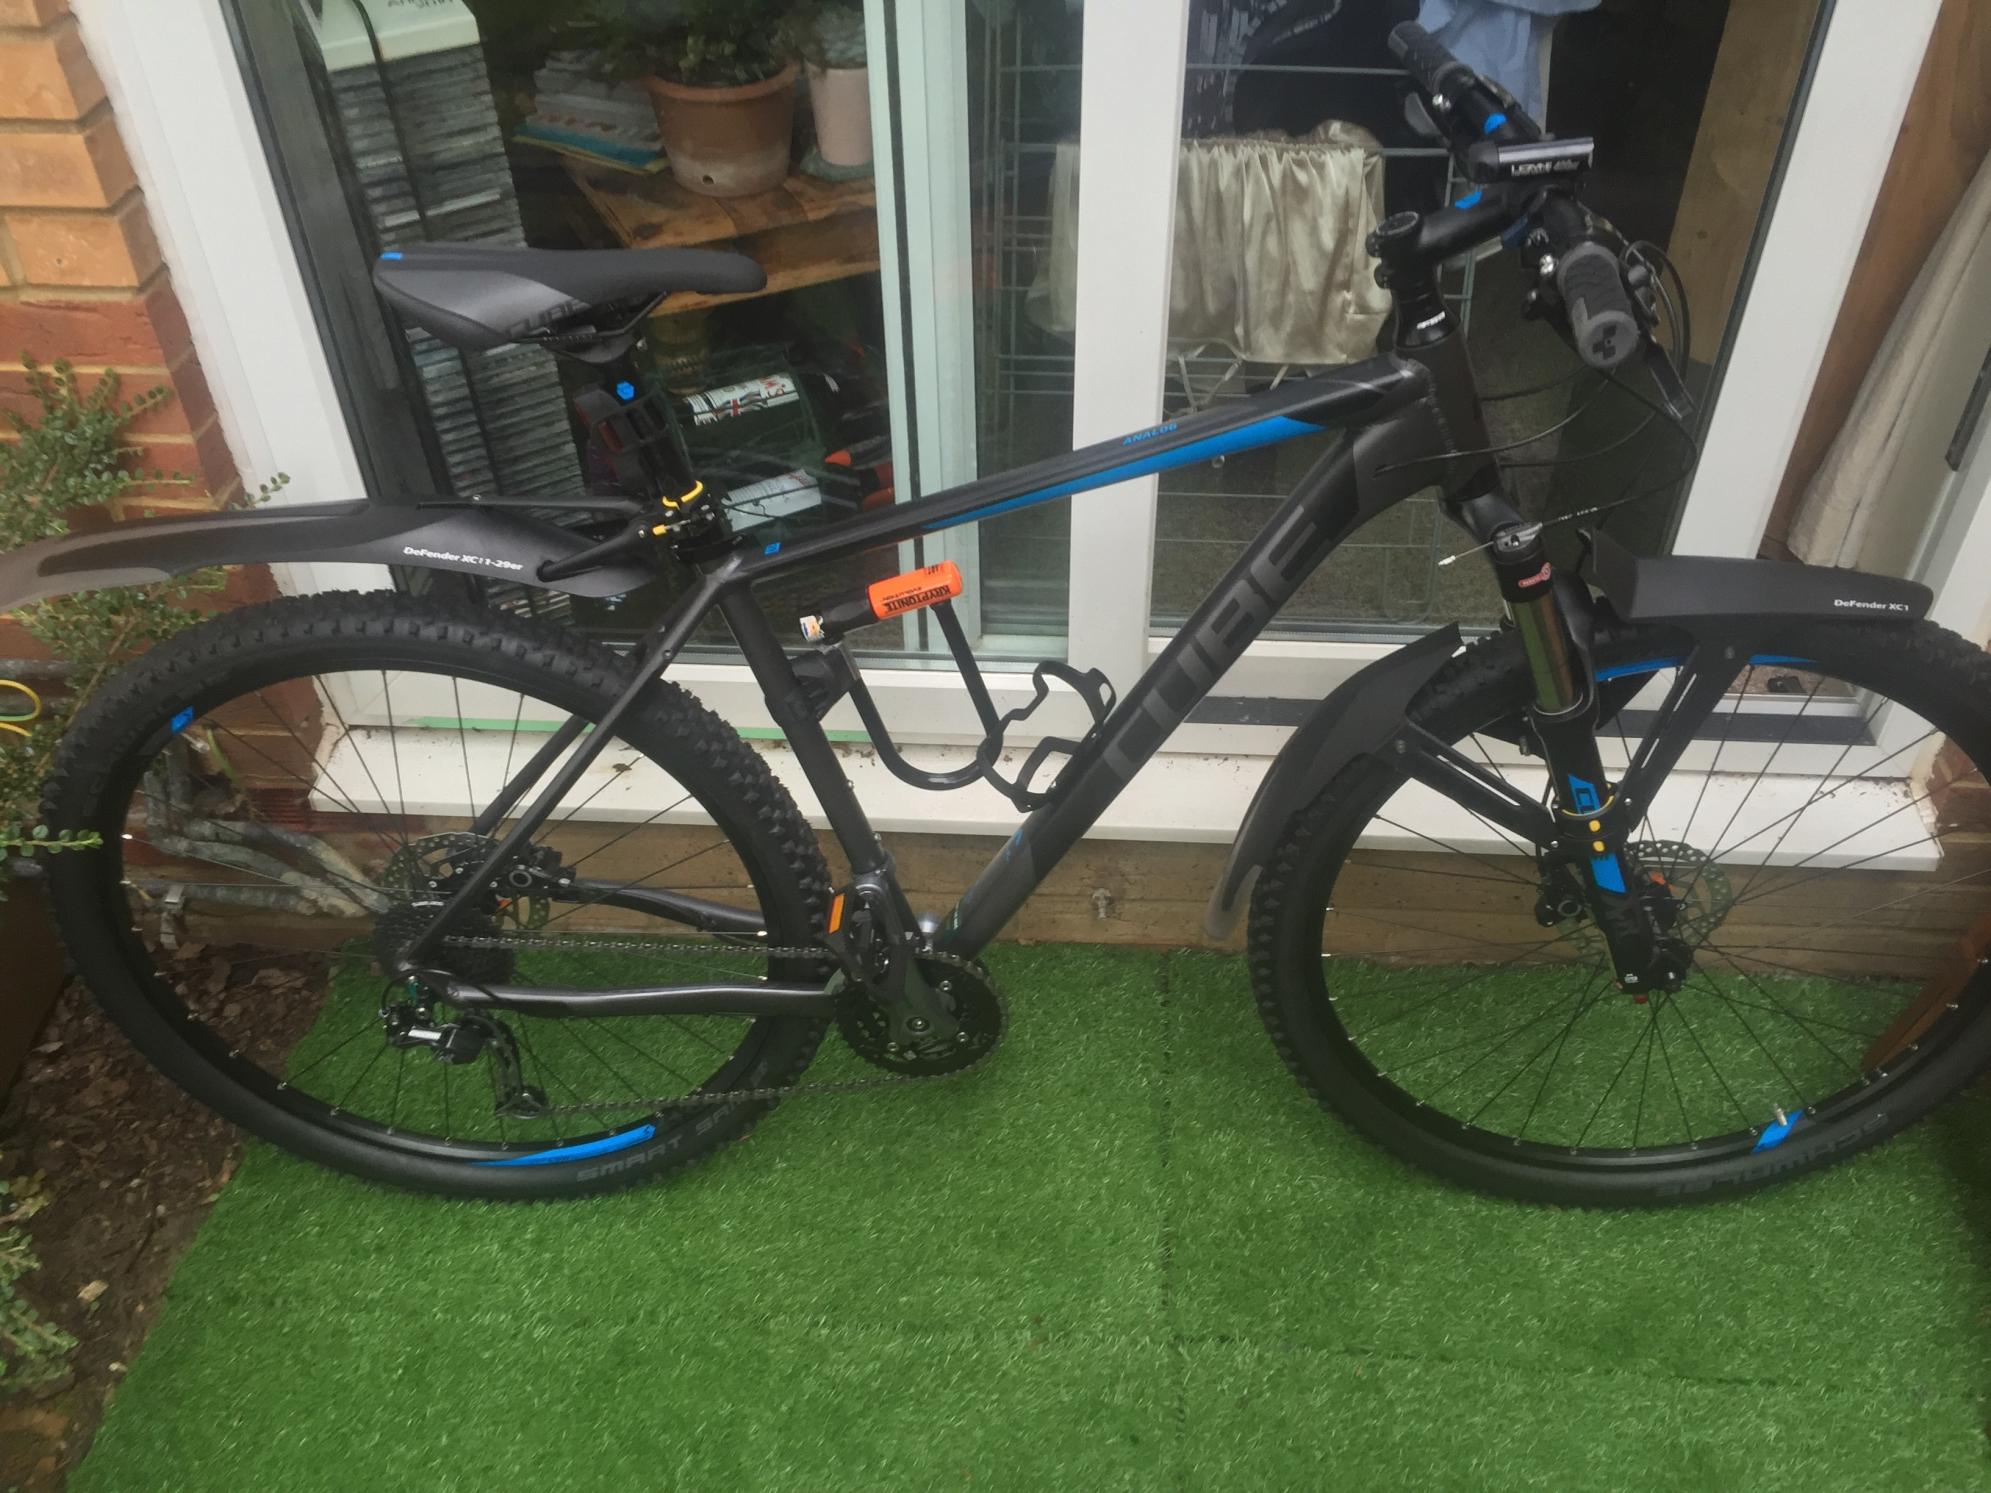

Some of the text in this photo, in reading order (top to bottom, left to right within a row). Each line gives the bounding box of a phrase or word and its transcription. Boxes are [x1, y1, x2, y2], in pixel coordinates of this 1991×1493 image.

[1122, 421, 1179, 447] ANALOG
[882, 584, 952, 613] KRYPTONITE
[1104, 503, 1333, 782] CUBE
[576, 1134, 683, 1183] SMART
